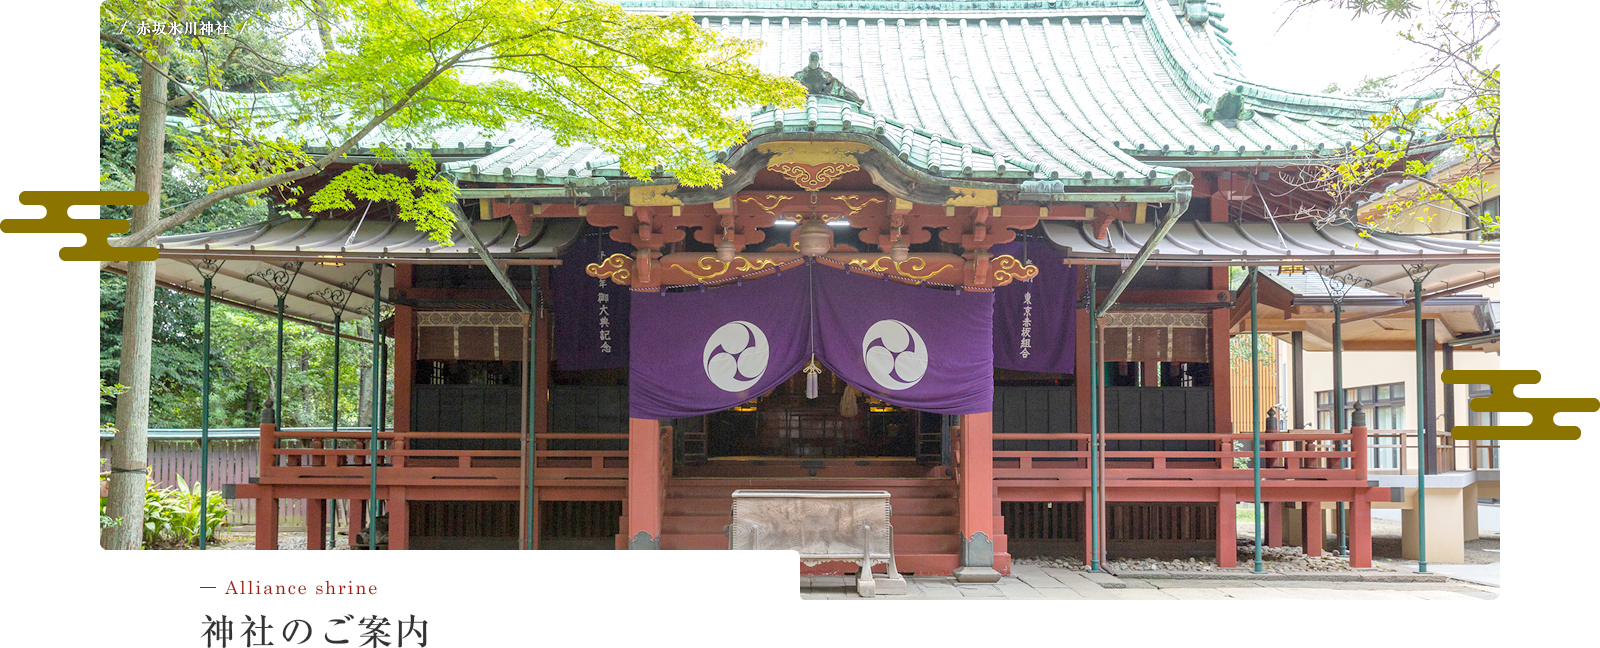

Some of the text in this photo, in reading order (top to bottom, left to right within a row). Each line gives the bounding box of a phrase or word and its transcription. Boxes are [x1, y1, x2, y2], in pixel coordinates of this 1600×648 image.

[597, 251, 612, 354] 年御大典記念
